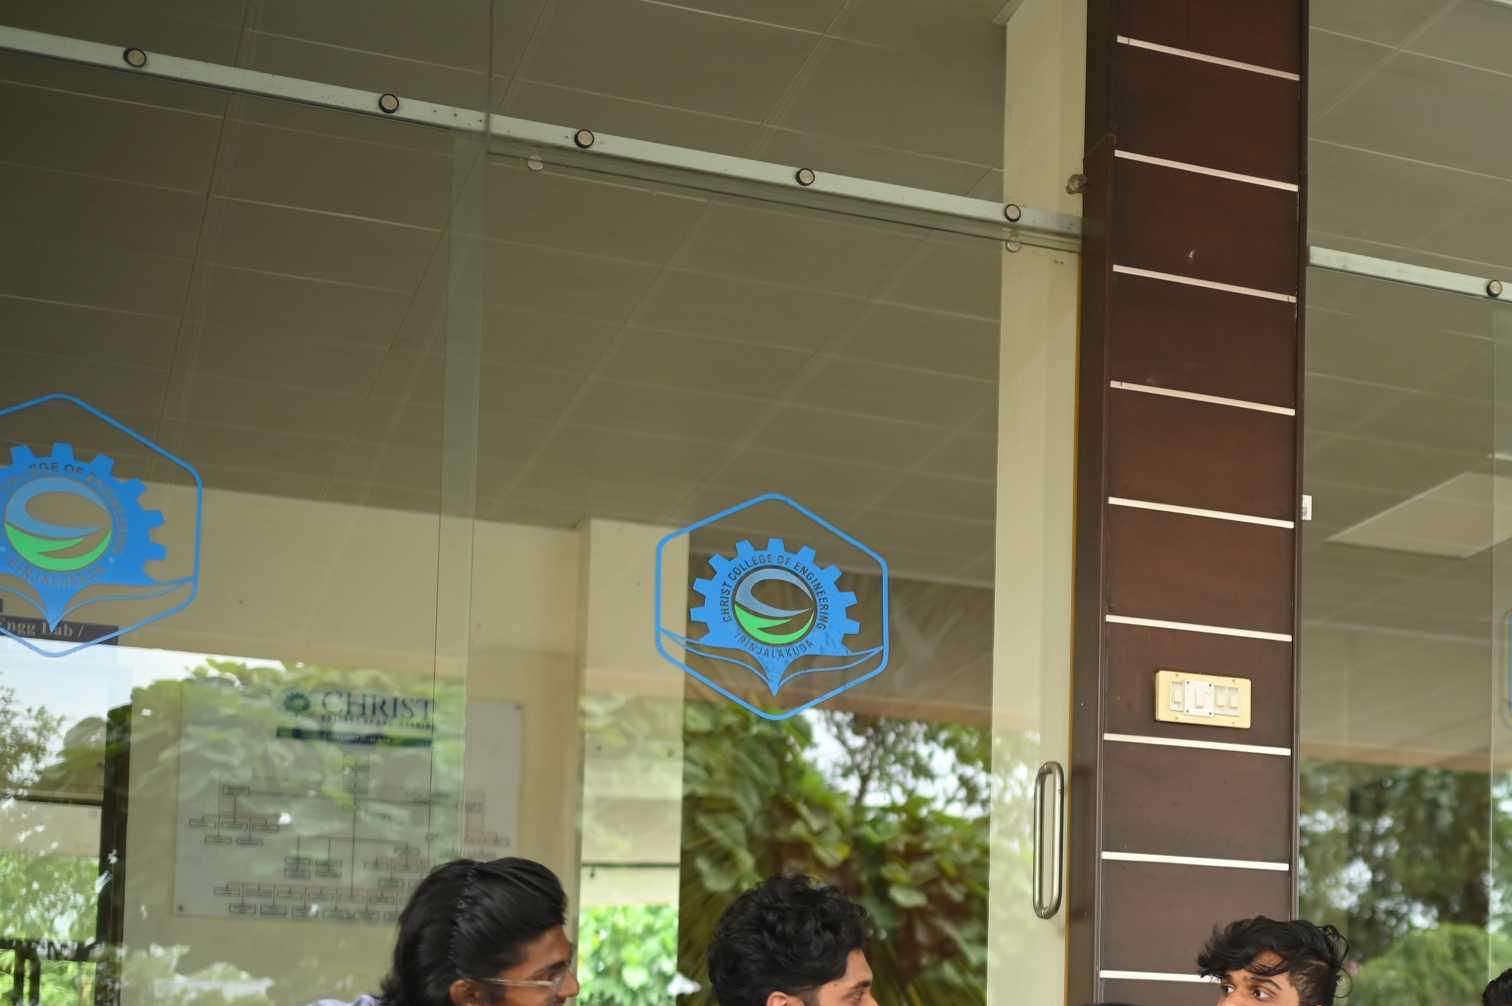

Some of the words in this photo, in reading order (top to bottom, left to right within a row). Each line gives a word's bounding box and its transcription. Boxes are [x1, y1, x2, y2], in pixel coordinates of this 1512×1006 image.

[719, 580, 733, 623] CHRIST
[727, 554, 774, 581] COLLEGE
[777, 555, 792, 566] OF
[793, 562, 829, 631] ENGINEERING
[321, 690, 433, 720] CHRIST
